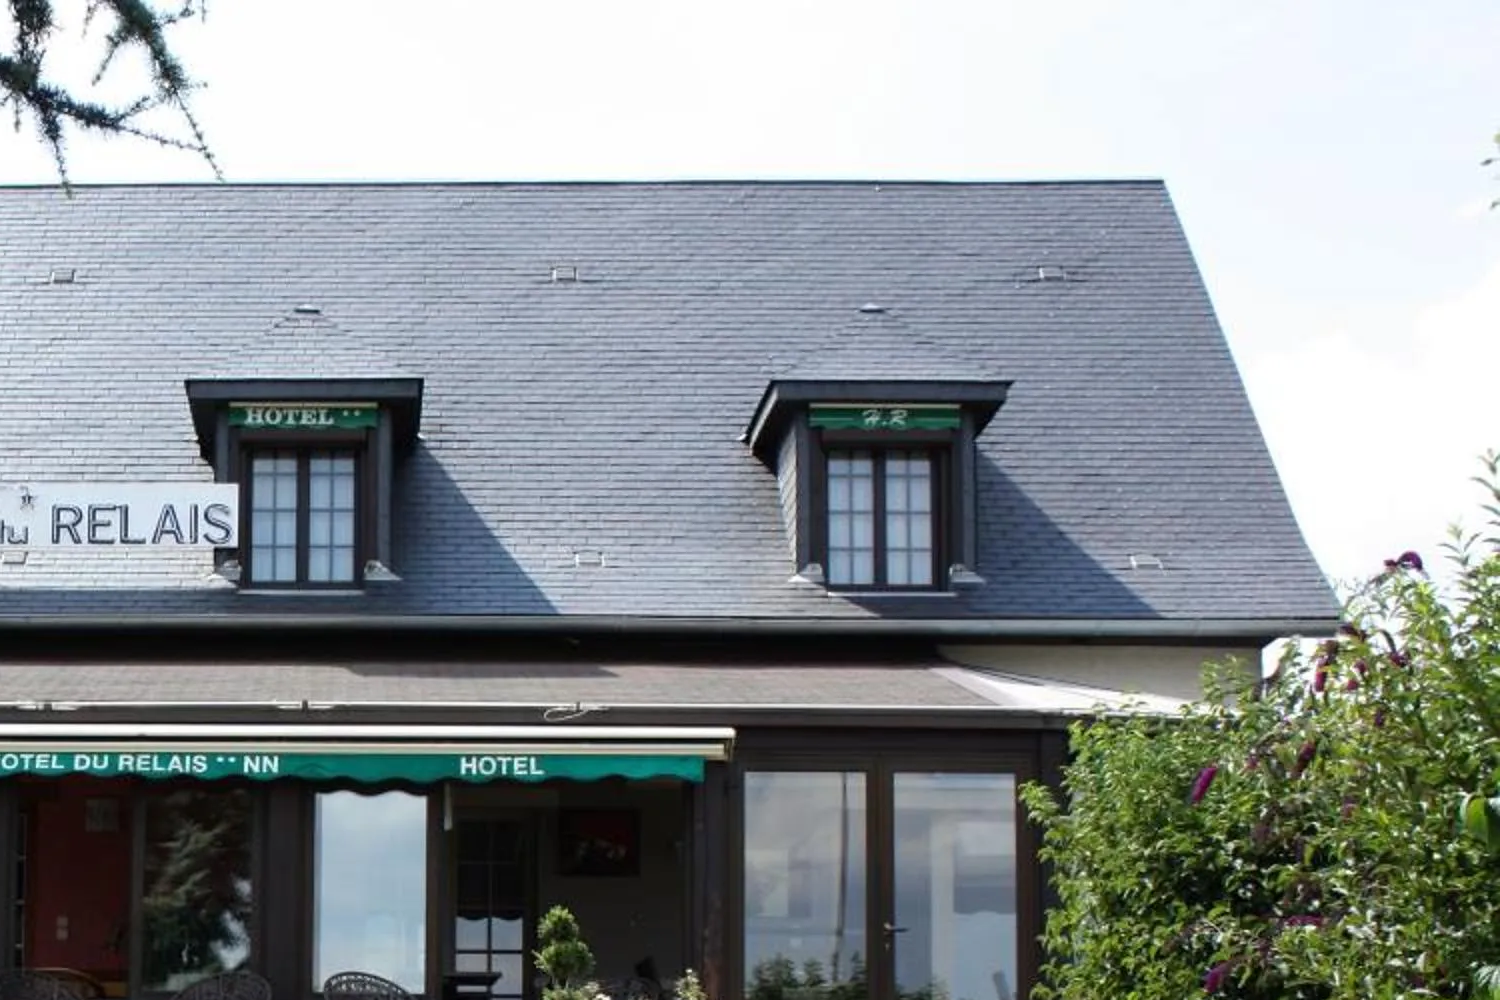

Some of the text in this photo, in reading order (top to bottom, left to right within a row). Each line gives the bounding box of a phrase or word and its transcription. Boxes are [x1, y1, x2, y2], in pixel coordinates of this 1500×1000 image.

[244, 407, 335, 425] HOTEL
[50, 503, 234, 546] RELAIS
[73, 754, 109, 770] DU
[118, 754, 209, 773] RELAIS
[243, 754, 280, 774] NN
[460, 756, 545, 775] HOTEL
